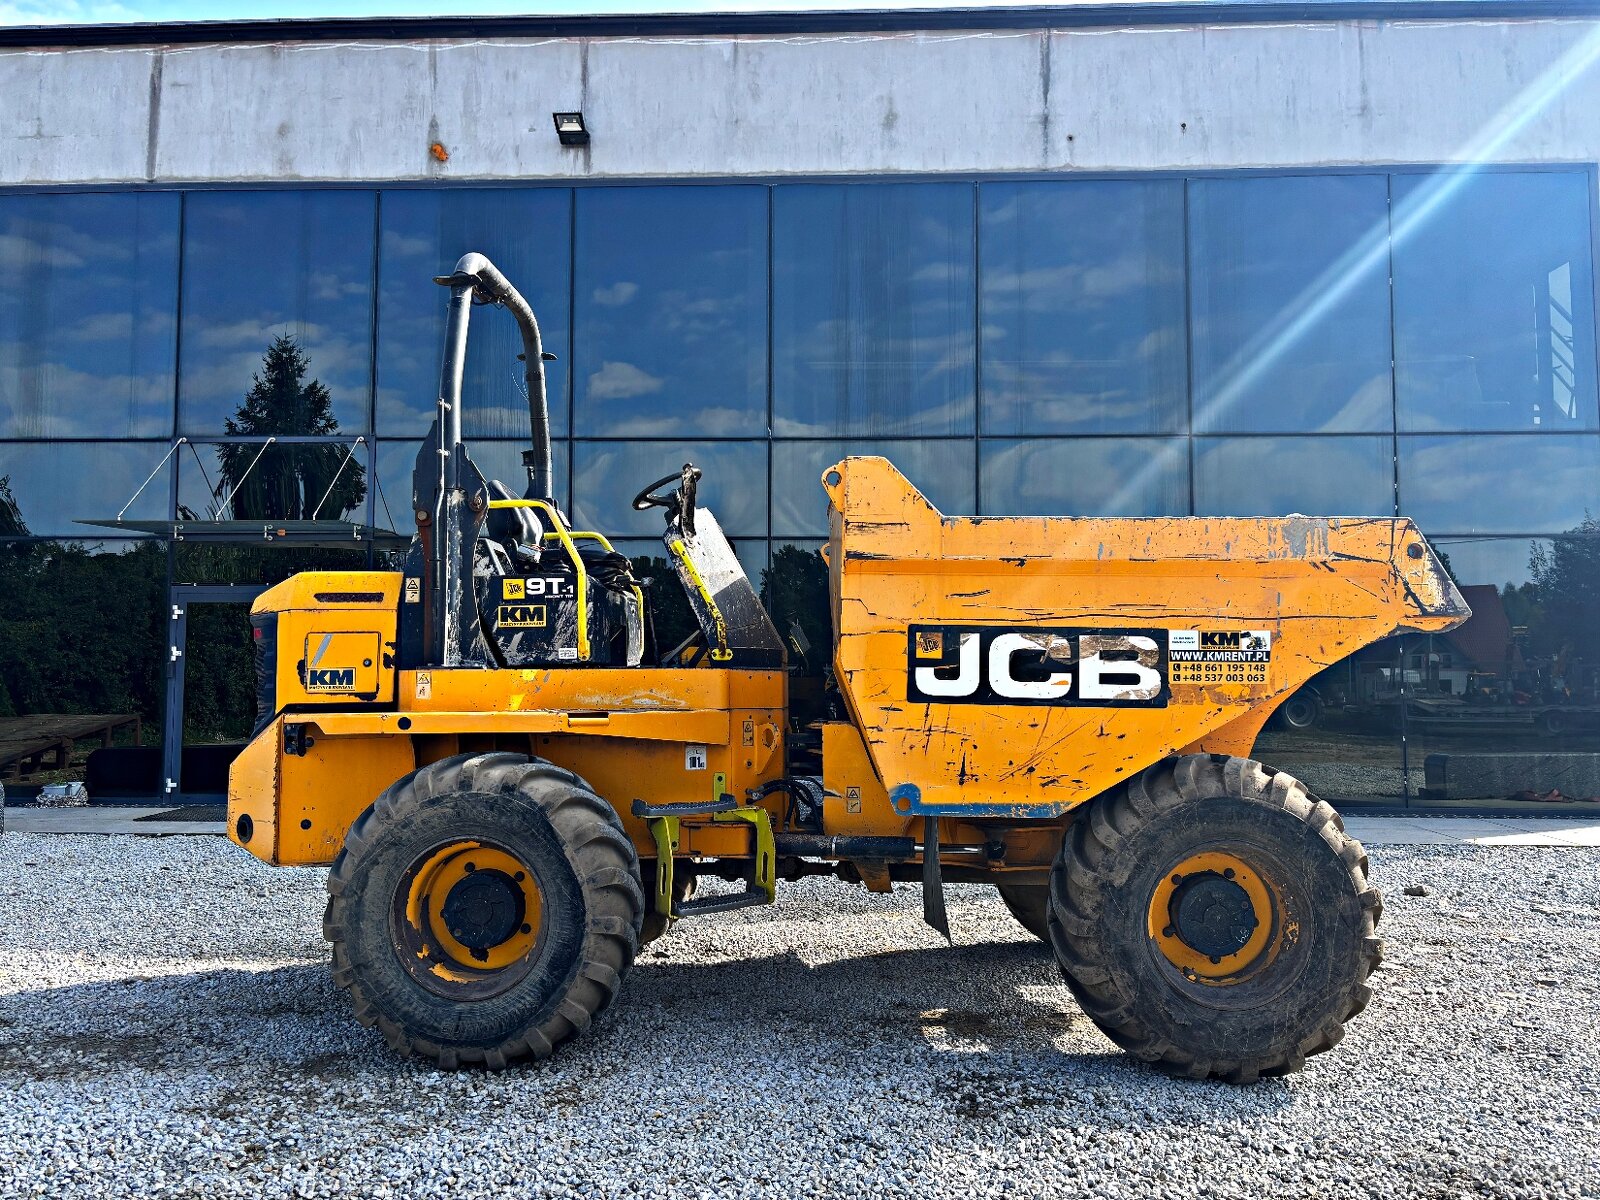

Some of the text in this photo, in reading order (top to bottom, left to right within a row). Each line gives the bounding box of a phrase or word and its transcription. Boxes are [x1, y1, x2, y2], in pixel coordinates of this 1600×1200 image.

[500, 606, 544, 622] KM
[1201, 632, 1239, 645] KM
[1170, 651, 1269, 662] WWW.KMRENT.PL
[915, 632, 1162, 699] JCB
[1183, 663, 1266, 672] +48 661 195 148
[310, 670, 353, 685] KM
[1183, 673, 1265, 682] +48 537 003 063
